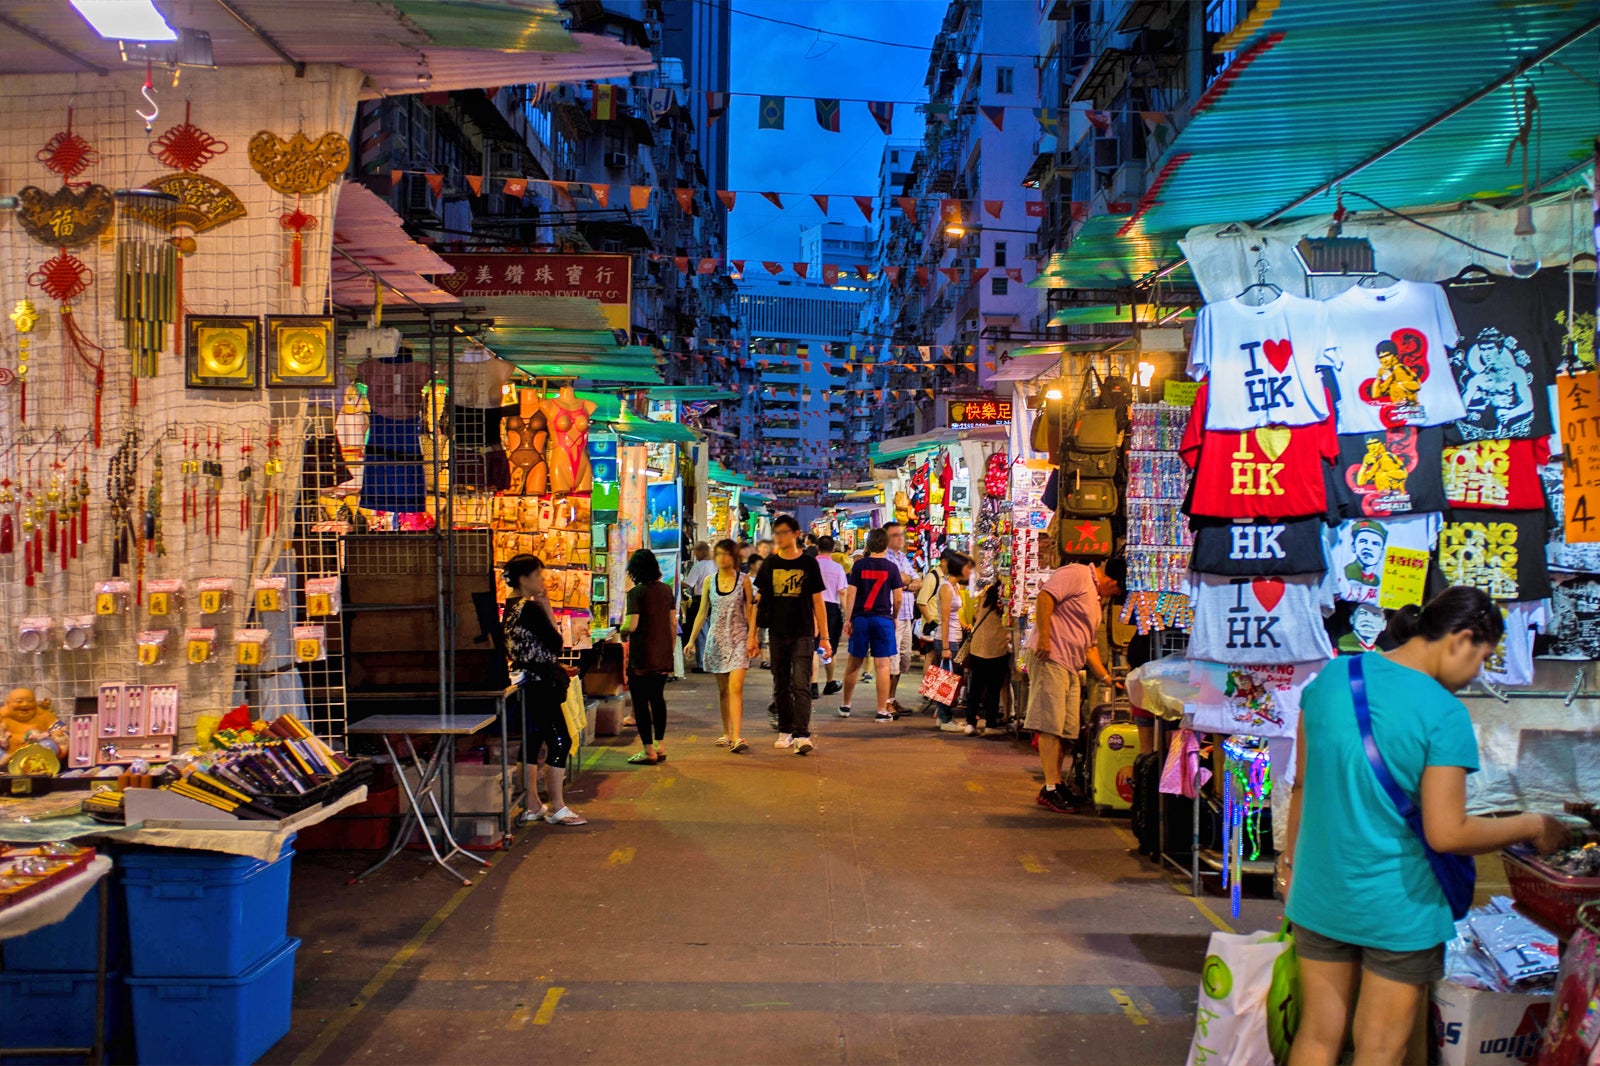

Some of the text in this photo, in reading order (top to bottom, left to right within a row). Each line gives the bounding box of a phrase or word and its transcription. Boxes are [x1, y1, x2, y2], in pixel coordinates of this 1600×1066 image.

[49, 209, 74, 237] 福
[475, 264, 615, 285] 美鑽珠寶行
[1240, 341, 1264, 377] I
[1245, 375, 1294, 412] HK
[965, 402, 1012, 420] 快樂足
[1232, 432, 1255, 460] I
[1230, 462, 1285, 495] HK
[1229, 525, 1287, 559] HK
[1440, 522, 1518, 546] HONG
[861, 570, 888, 611] 7
[1229, 578, 1250, 613] I
[1226, 616, 1282, 648] HK
